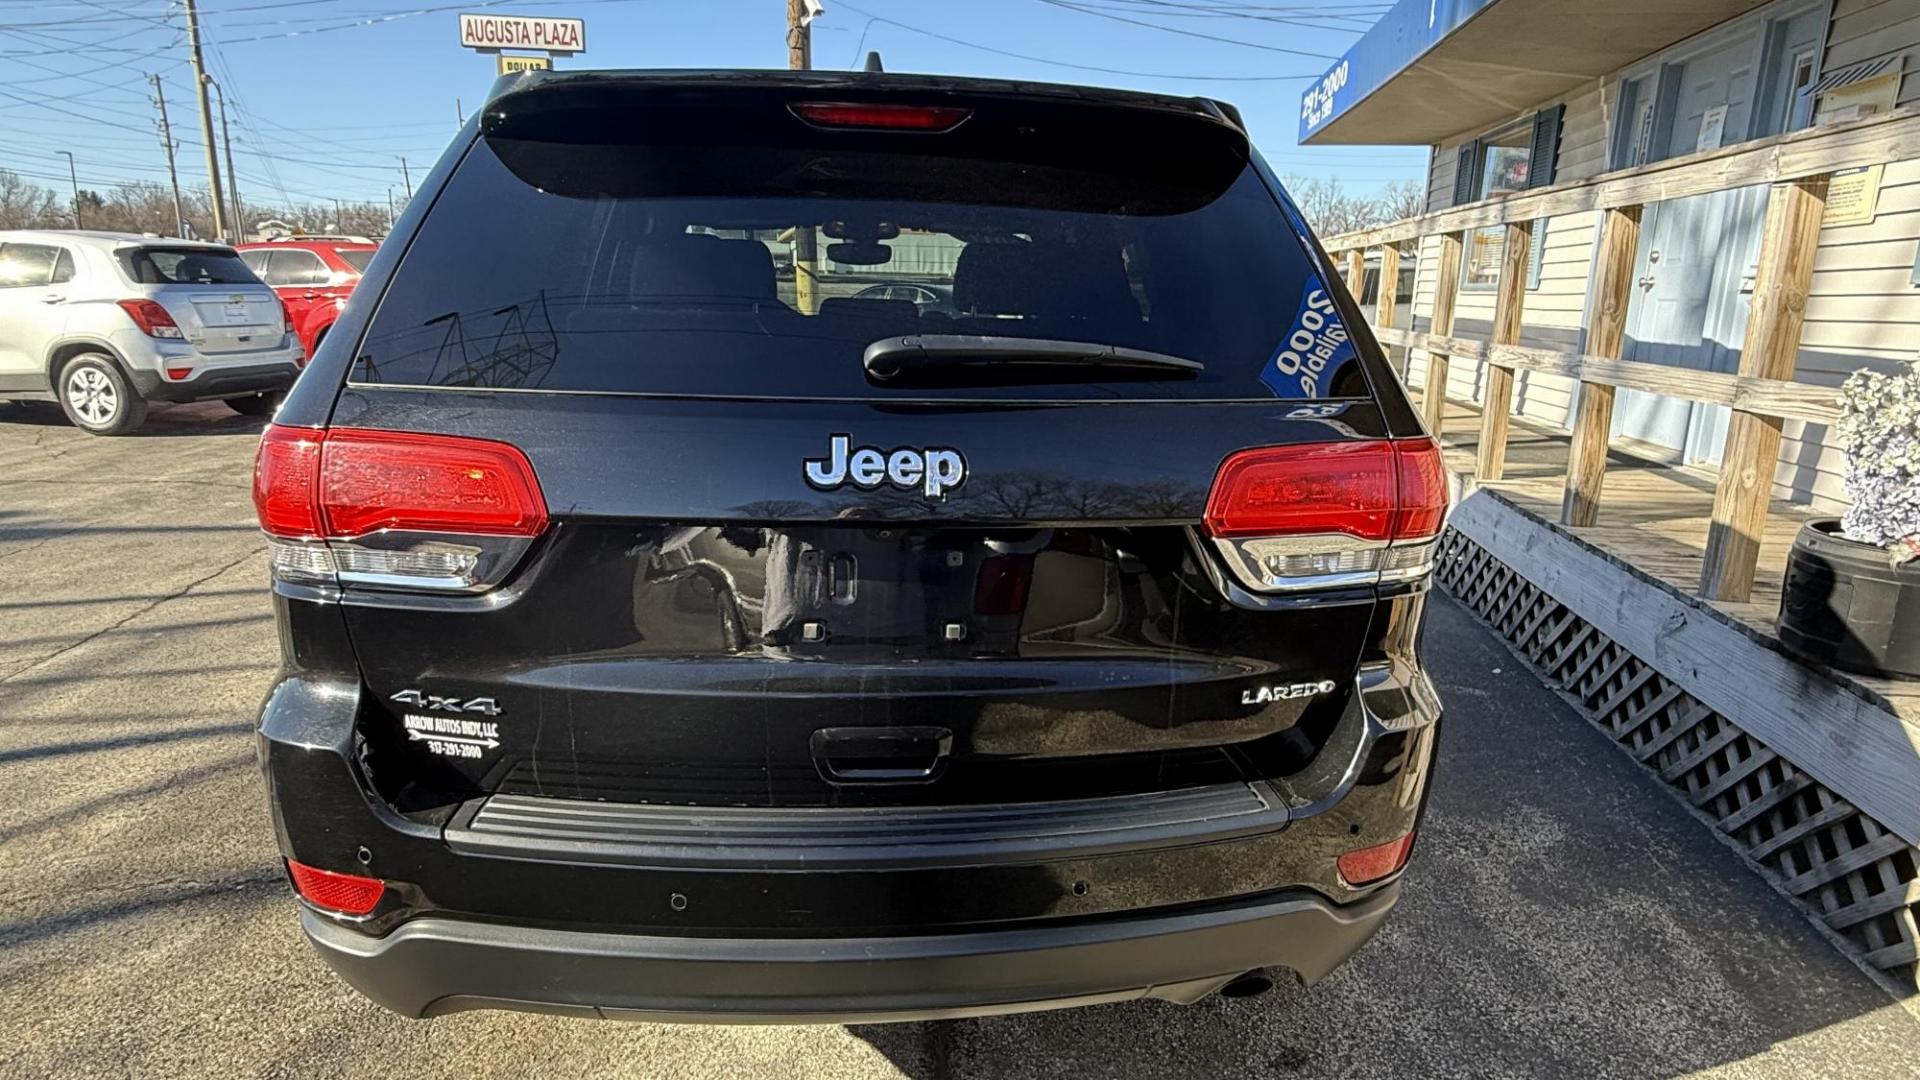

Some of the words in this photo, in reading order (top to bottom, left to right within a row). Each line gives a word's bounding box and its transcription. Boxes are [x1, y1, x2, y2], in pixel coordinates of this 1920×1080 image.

[465, 18, 531, 44] AUGUSTA
[534, 22, 579, 46] PLAZA
[1302, 60, 1349, 119] 291-2000
[805, 435, 964, 497] Jeep
[1241, 680, 1336, 705] LAREDO
[404, 714, 434, 731] ARROW
[434, 717, 461, 734] AUTOS
[428, 740, 482, 759] 317-291-2000
